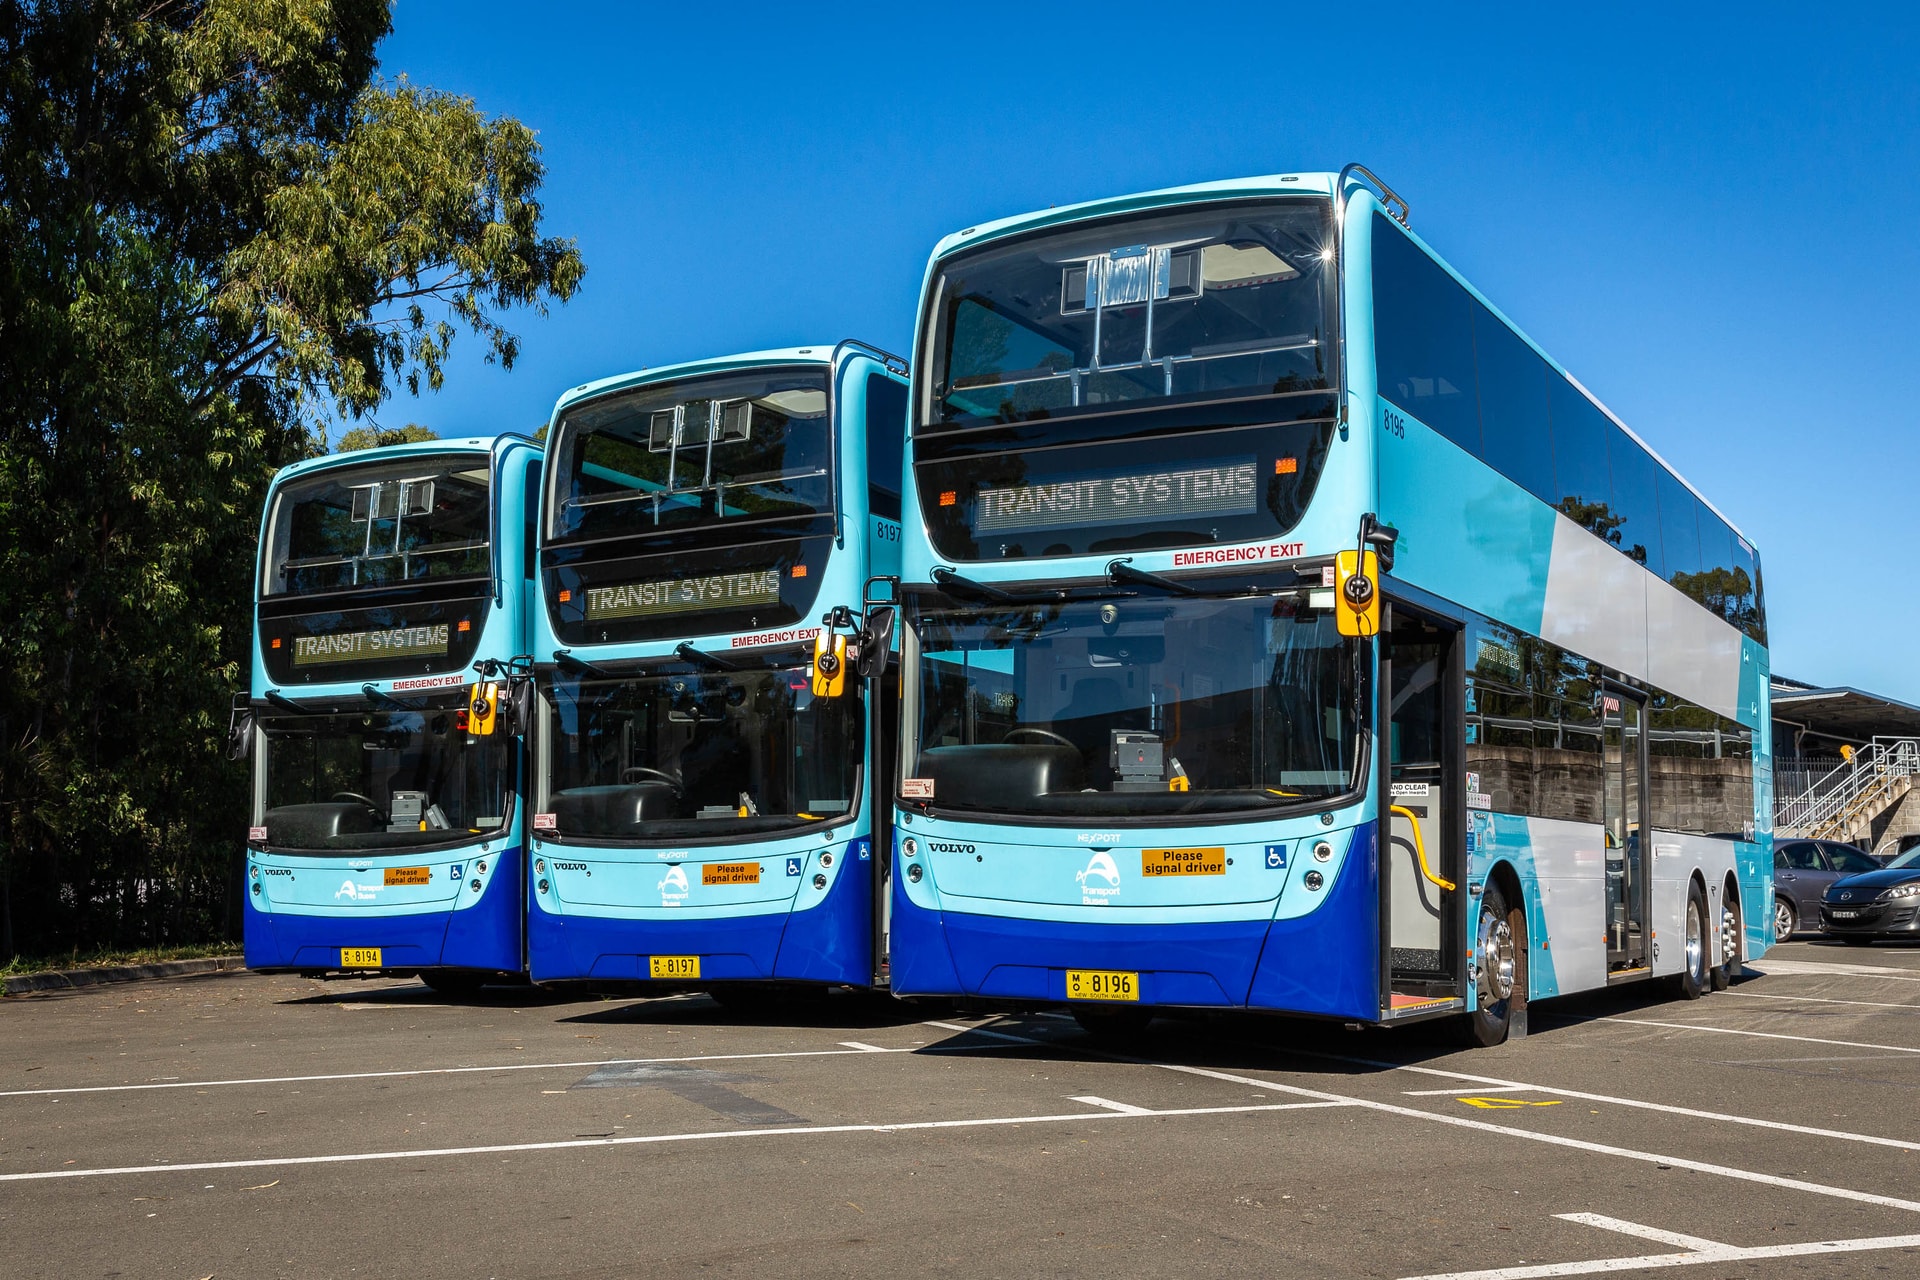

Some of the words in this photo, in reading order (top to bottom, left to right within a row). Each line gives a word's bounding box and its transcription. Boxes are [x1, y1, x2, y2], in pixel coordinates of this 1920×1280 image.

[1383, 408, 1405, 440] 8196
[979, 480, 1100, 517] TRANSIT
[1111, 463, 1255, 505] SYSTEMS
[877, 521, 901, 543] 8197
[1174, 547, 1266, 567] EMERGENCY
[1270, 543, 1303, 559] EXIT
[588, 581, 674, 610] TRANSIT
[681, 570, 780, 599] SYSTEMS
[296, 632, 365, 656] TRANSIT
[371, 625, 448, 650] SYSTEMS
[732, 631, 796, 648] EMERGENCY
[798, 628, 822, 641] EXIT
[393, 678, 442, 690] EMERGENCY
[445, 675, 464, 686] EXIT
[929, 842, 975, 854] VOLVO
[1163, 852, 1203, 861] Please
[554, 863, 587, 871] VOLVO
[717, 865, 745, 873] Please
[1145, 863, 1181, 874] signal
[1185, 862, 1222, 873] driver
[385, 877, 406, 885] signal
[704, 874, 730, 884] signal
[732, 873, 758, 882] driver
[662, 892, 688, 900] Transport
[1081, 886, 1121, 896] Transport
[1082, 896, 1109, 905] Buses
[355, 951, 377, 962] 8194
[668, 959, 694, 973] 8197
[1092, 975, 1131, 993] 8196
